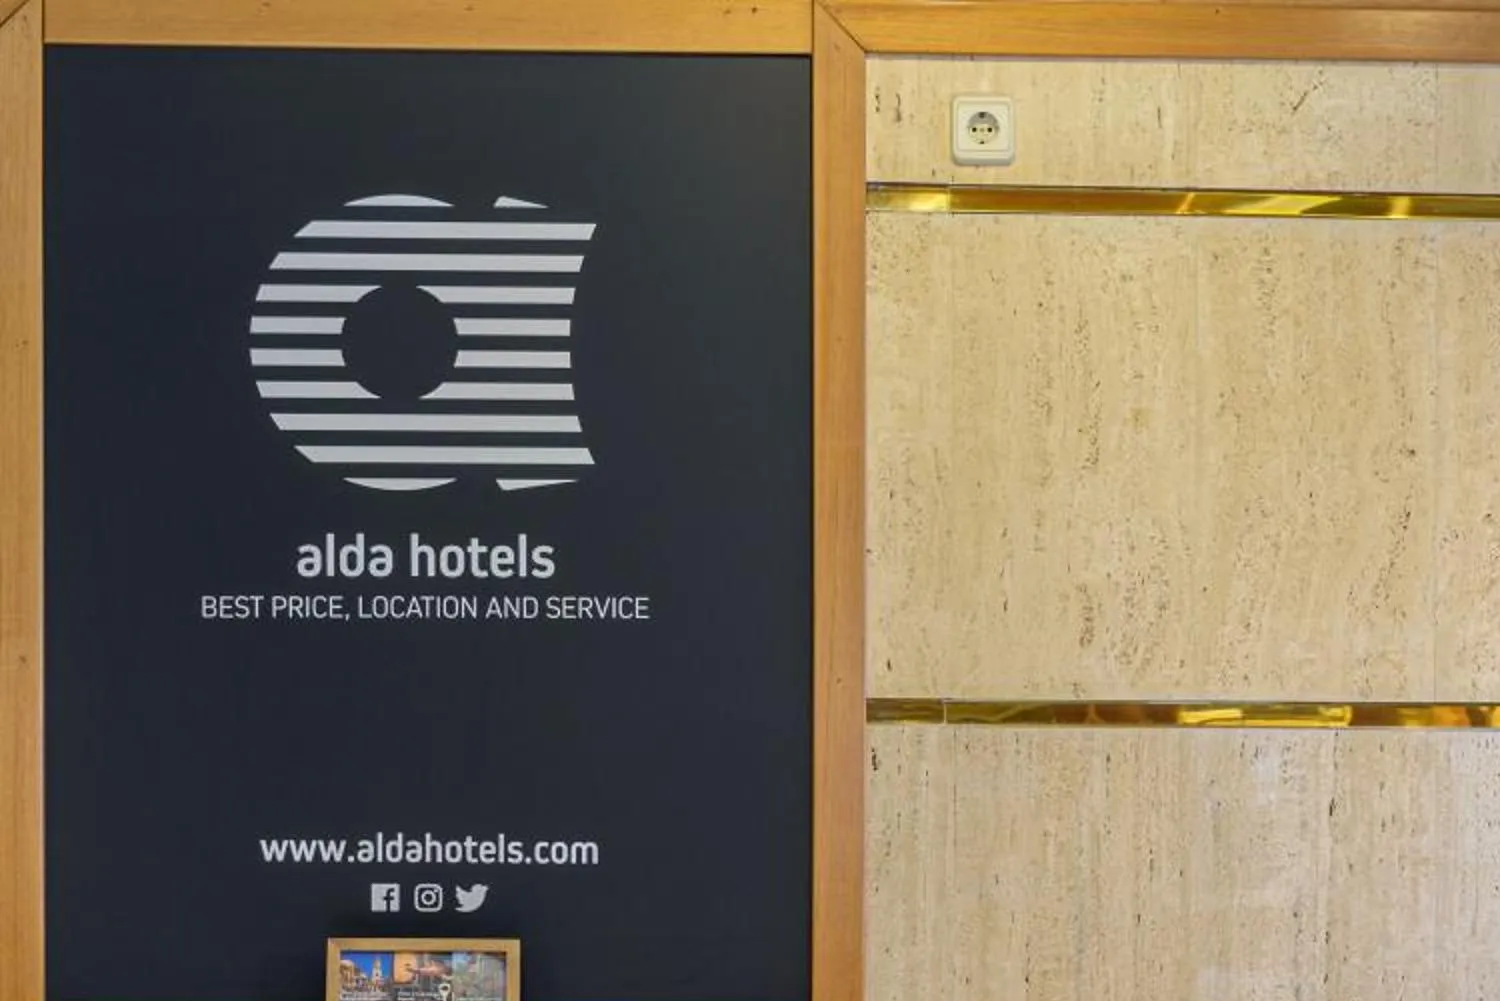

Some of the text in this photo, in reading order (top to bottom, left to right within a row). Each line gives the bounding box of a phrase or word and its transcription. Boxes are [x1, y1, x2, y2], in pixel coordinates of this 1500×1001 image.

[297, 532, 556, 579] alda hotels
[201, 595, 650, 621] BEST PRICE, LOCATION AND SERVICE
[259, 831, 600, 866] www.aldahotels.com
